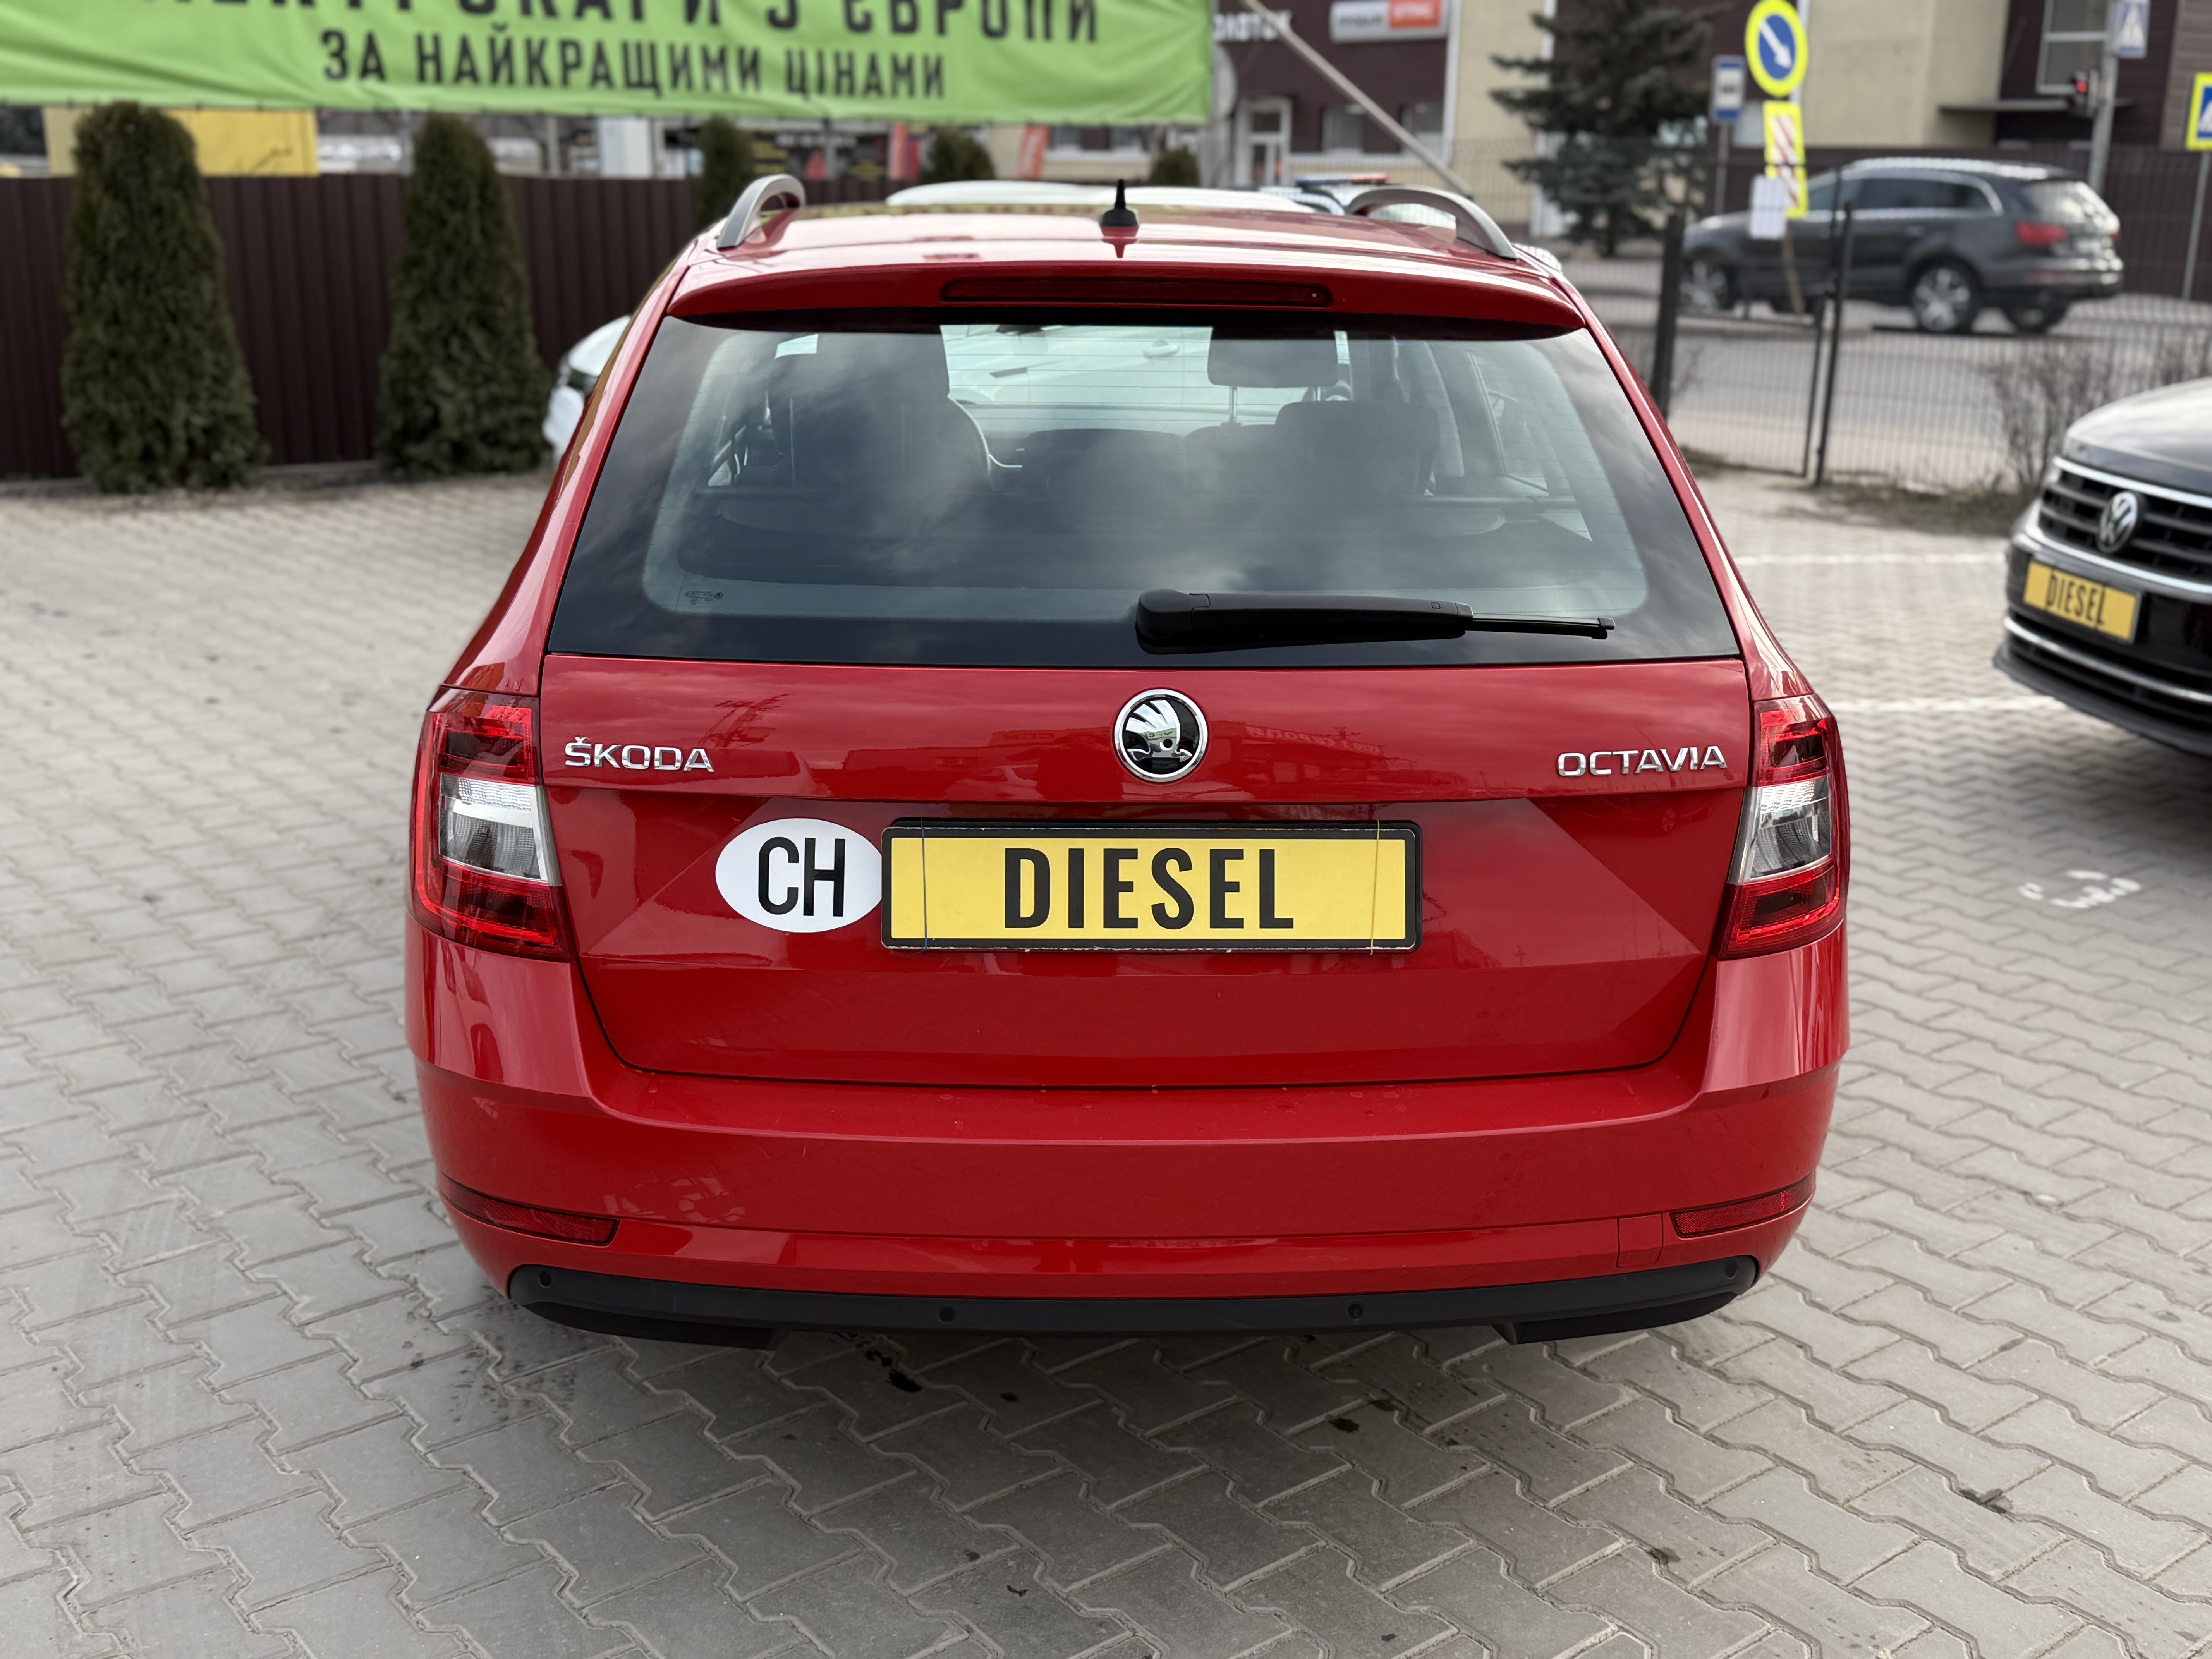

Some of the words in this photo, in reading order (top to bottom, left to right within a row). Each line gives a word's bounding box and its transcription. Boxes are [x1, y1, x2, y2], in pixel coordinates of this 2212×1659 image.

[321, 29, 386, 81] ЗА
[416, 22, 761, 98] НАЙКРАЩИМИ
[786, 49, 943, 100] ЦІНАМИ
[2045, 574, 2106, 626] DIESEL
[565, 737, 714, 772] ŠKODA
[1557, 745, 1727, 777] OCTAVIA
[758, 836, 846, 917] CH
[1005, 847, 1294, 929] DIESEL
